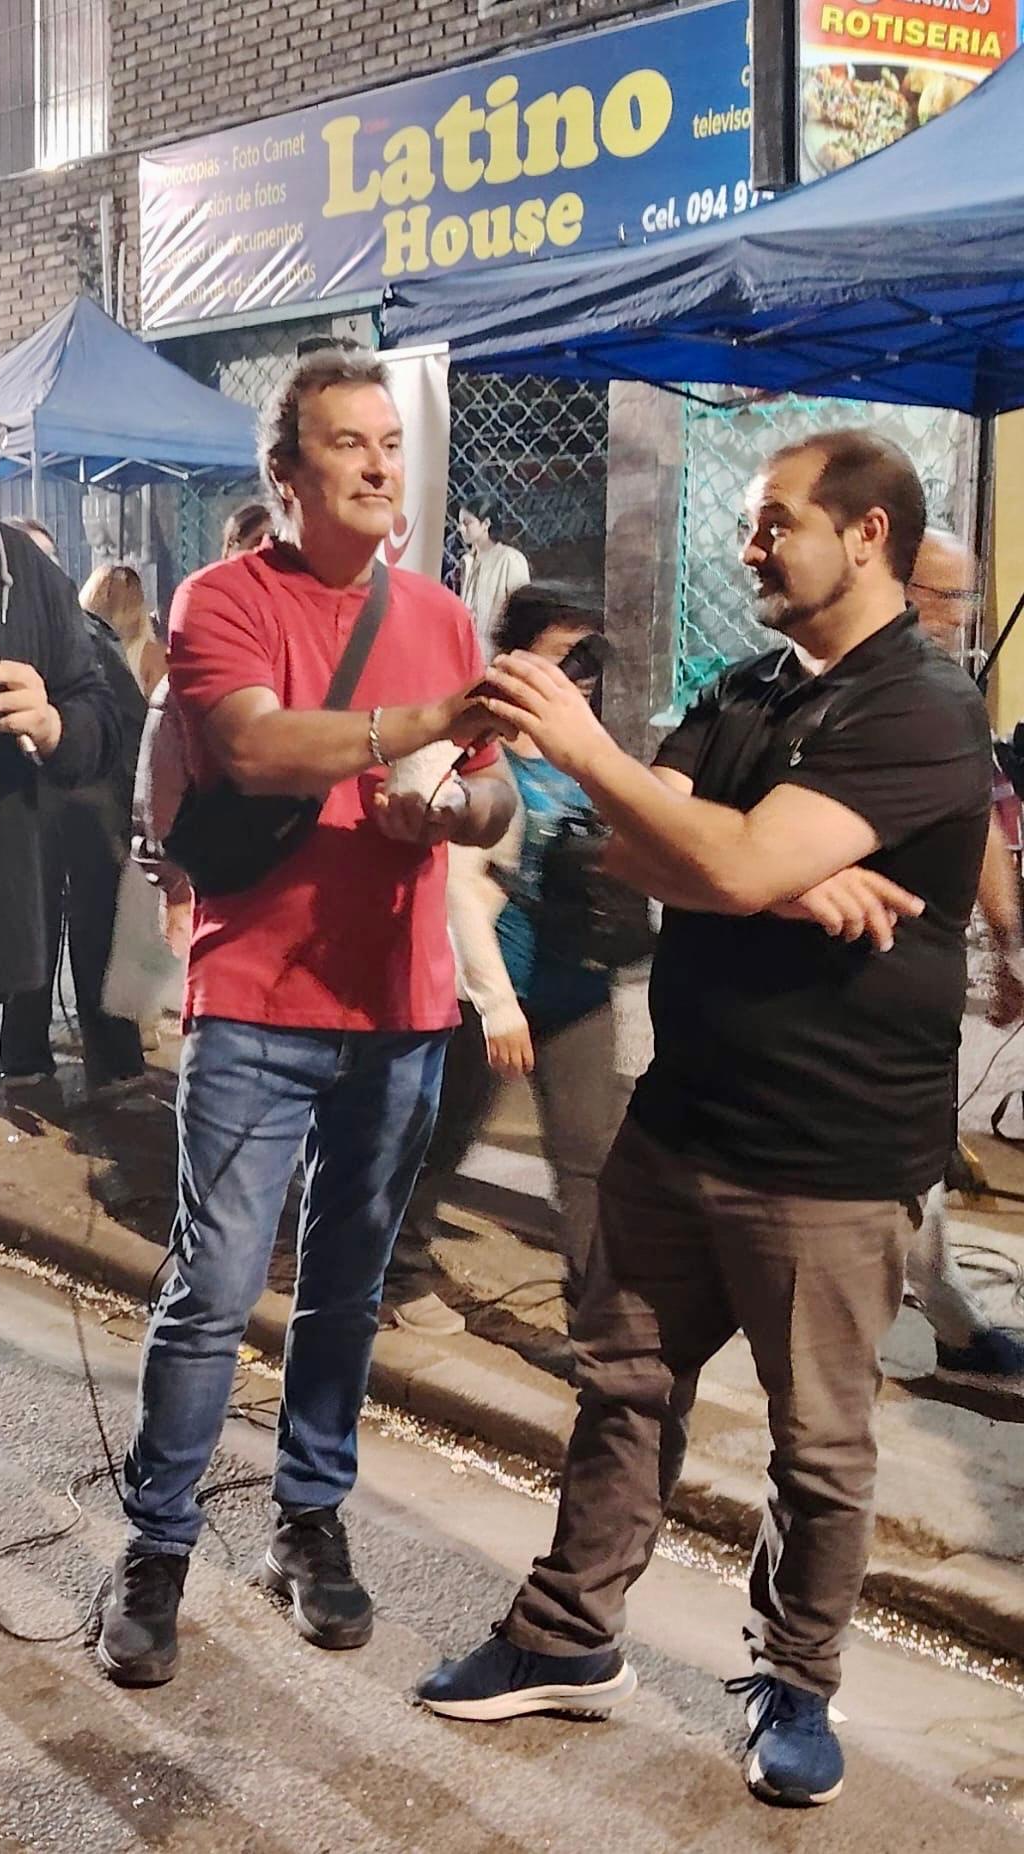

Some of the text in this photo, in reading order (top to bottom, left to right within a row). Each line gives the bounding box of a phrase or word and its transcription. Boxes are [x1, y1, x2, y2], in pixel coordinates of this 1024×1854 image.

[820, 5, 1003, 59] ROTISERIA
[321, 68, 674, 219] Latino
[692, 103, 752, 139] televiso
[232, 145, 260, 171] Foto
[263, 130, 305, 163] Carnet
[235, 186, 252, 212] de
[253, 180, 287, 209] fotos
[641, 196, 681, 232] Cel.
[686, 183, 728, 225] 094
[381, 191, 584, 276] House
